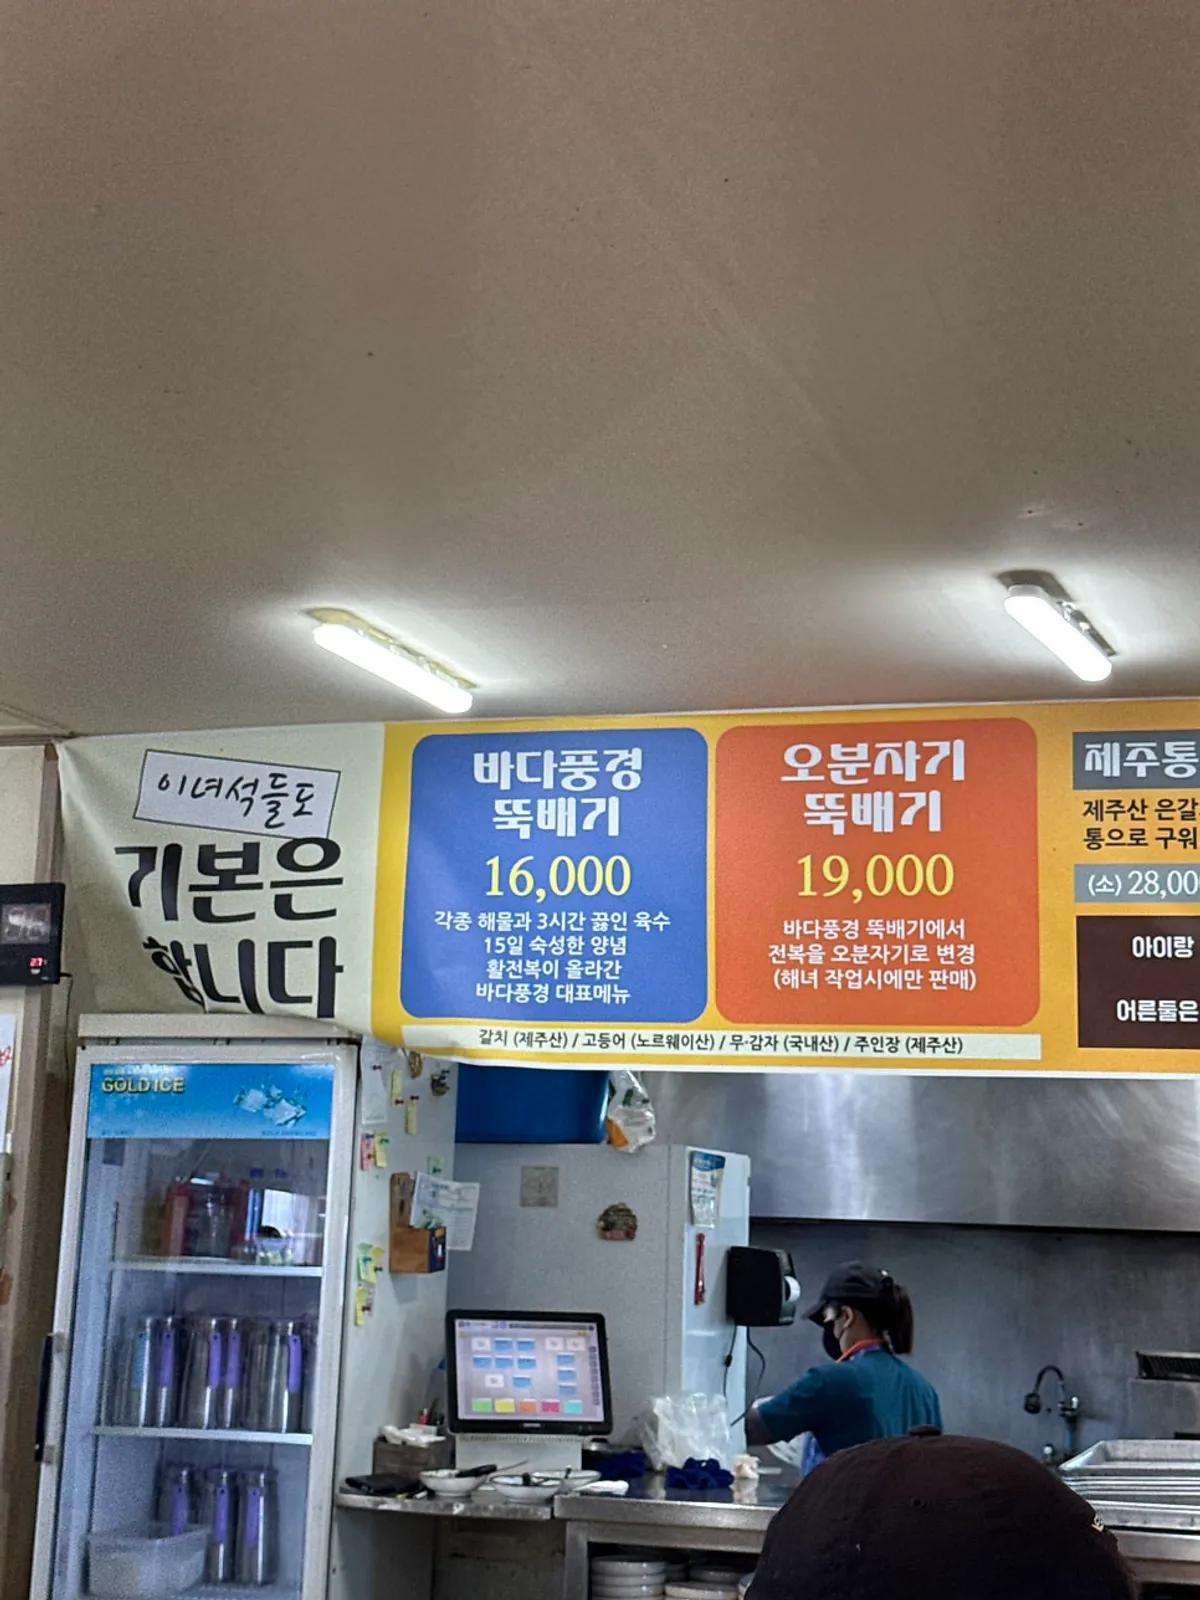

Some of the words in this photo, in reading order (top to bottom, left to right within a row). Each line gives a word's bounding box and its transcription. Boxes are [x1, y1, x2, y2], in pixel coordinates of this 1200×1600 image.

[473, 747, 643, 792] 바다풍경
[781, 739, 965, 785] 오분자기
[1084, 741, 1200, 778] 제주통
[157, 772, 315, 829] 이녀석들도
[803, 790, 941, 836] 뚝배기
[1082, 799, 1149, 822] 제주산
[1154, 797, 1200, 822] 은갈
[493, 797, 619, 839] 뚝배기
[1083, 827, 1150, 850] 통으로
[1154, 826, 1198, 850] 구워
[114, 837, 344, 924] 기본은
[486, 856, 630, 903] 16,000
[798, 854, 953, 903] 19,000
[1087, 873, 1122, 897] (소)
[1127, 870, 1200, 900] 28,00
[434, 910, 473, 932] 각종
[477, 911, 533, 932] 해물과
[536, 911, 587, 932] 3시간
[590, 911, 628, 932] 끓인
[633, 911, 671, 932] 육수
[783, 919, 859, 940] 바다풍경
[865, 918, 965, 940] 뚝배기에서
[484, 935, 523, 956] 15일
[528, 935, 586, 956] 숙성한
[590, 935, 627, 956] 양념
[768, 943, 826, 965] 전복을
[830, 943, 931, 965] 오분자기로
[936, 943, 975, 965] 변경
[1131, 935, 1195, 959] 아이랑
[142, 935, 344, 1019] 합니다
[486, 959, 559, 980] 활전복이
[564, 959, 623, 980] 올라간
[773, 968, 818, 990] (해녀
[825, 968, 924, 990] 작업시에만
[928, 969, 977, 991] 판매)
[475, 982, 549, 1004] 바다풍경
[555, 983, 631, 1005] 대표메뉴
[1116, 999, 1199, 1023] 어른둘은
[479, 1028, 508, 1046] 갈치
[513, 1031, 568, 1049] (제주산)
[571, 1032, 580, 1049] /
[582, 1032, 626, 1050] 고등어
[631, 1032, 715, 1051] (노르웨이산)
[718, 1035, 727, 1051] /
[783, 1035, 840, 1053] (국내산)
[843, 1036, 851, 1053] /
[854, 1035, 901, 1054] 주인장
[905, 1036, 963, 1055] (제주산)
[101, 1077, 149, 1095] GOLD
[152, 1077, 186, 1094] ICE
